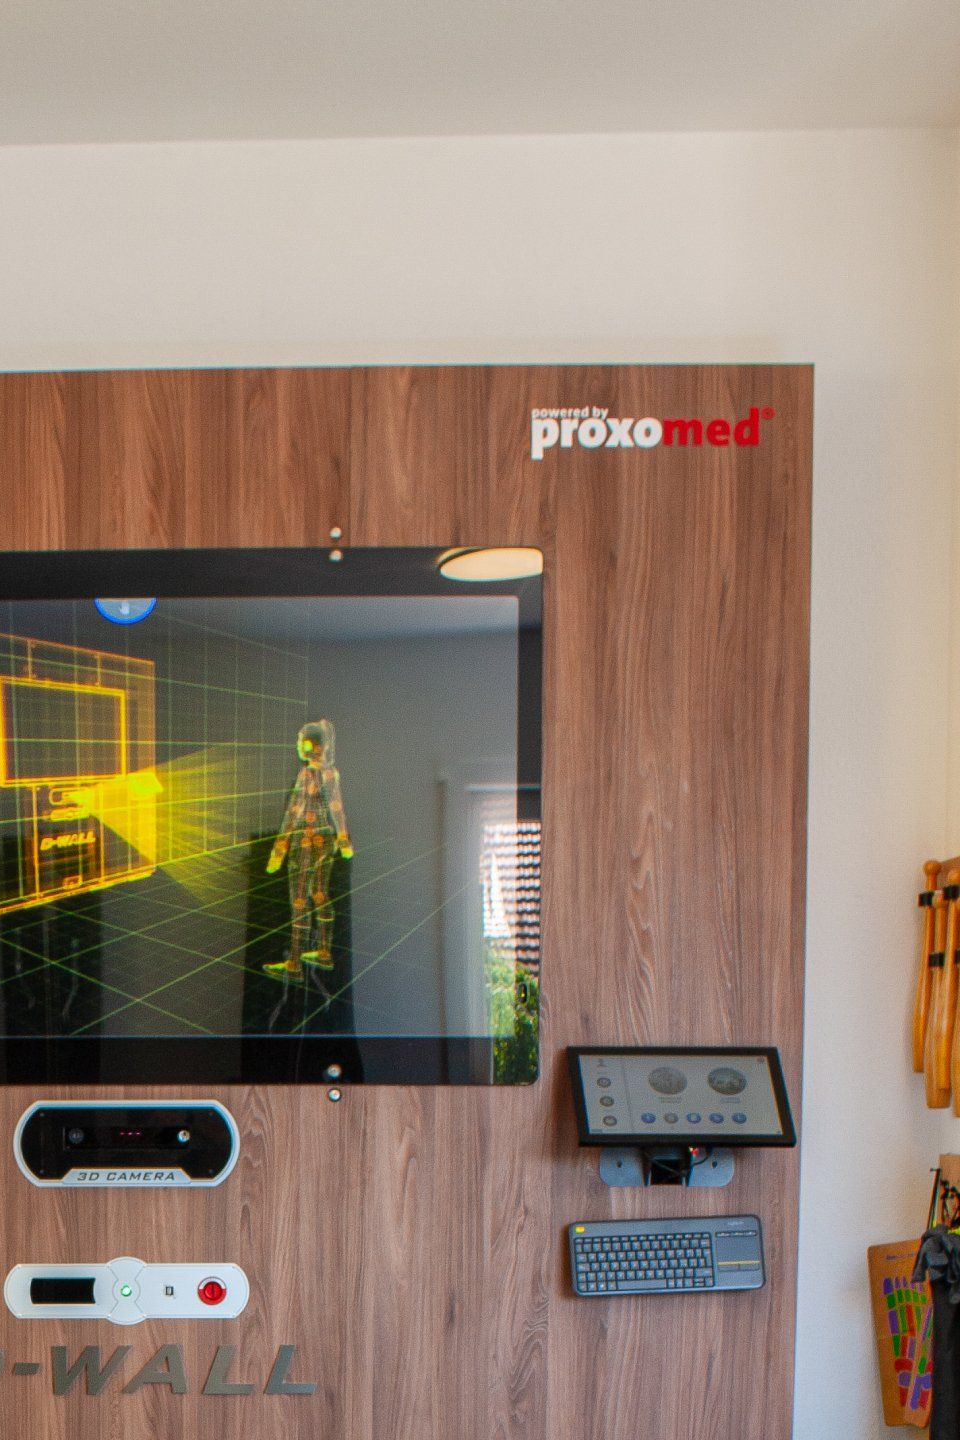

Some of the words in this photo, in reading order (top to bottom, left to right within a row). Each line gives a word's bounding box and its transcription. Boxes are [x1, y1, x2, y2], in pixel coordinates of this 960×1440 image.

[531, 406, 589, 419] powered
[591, 406, 609, 420] by
[77, 1172, 100, 1181] 3D
[106, 1172, 176, 1181] CAMERA
